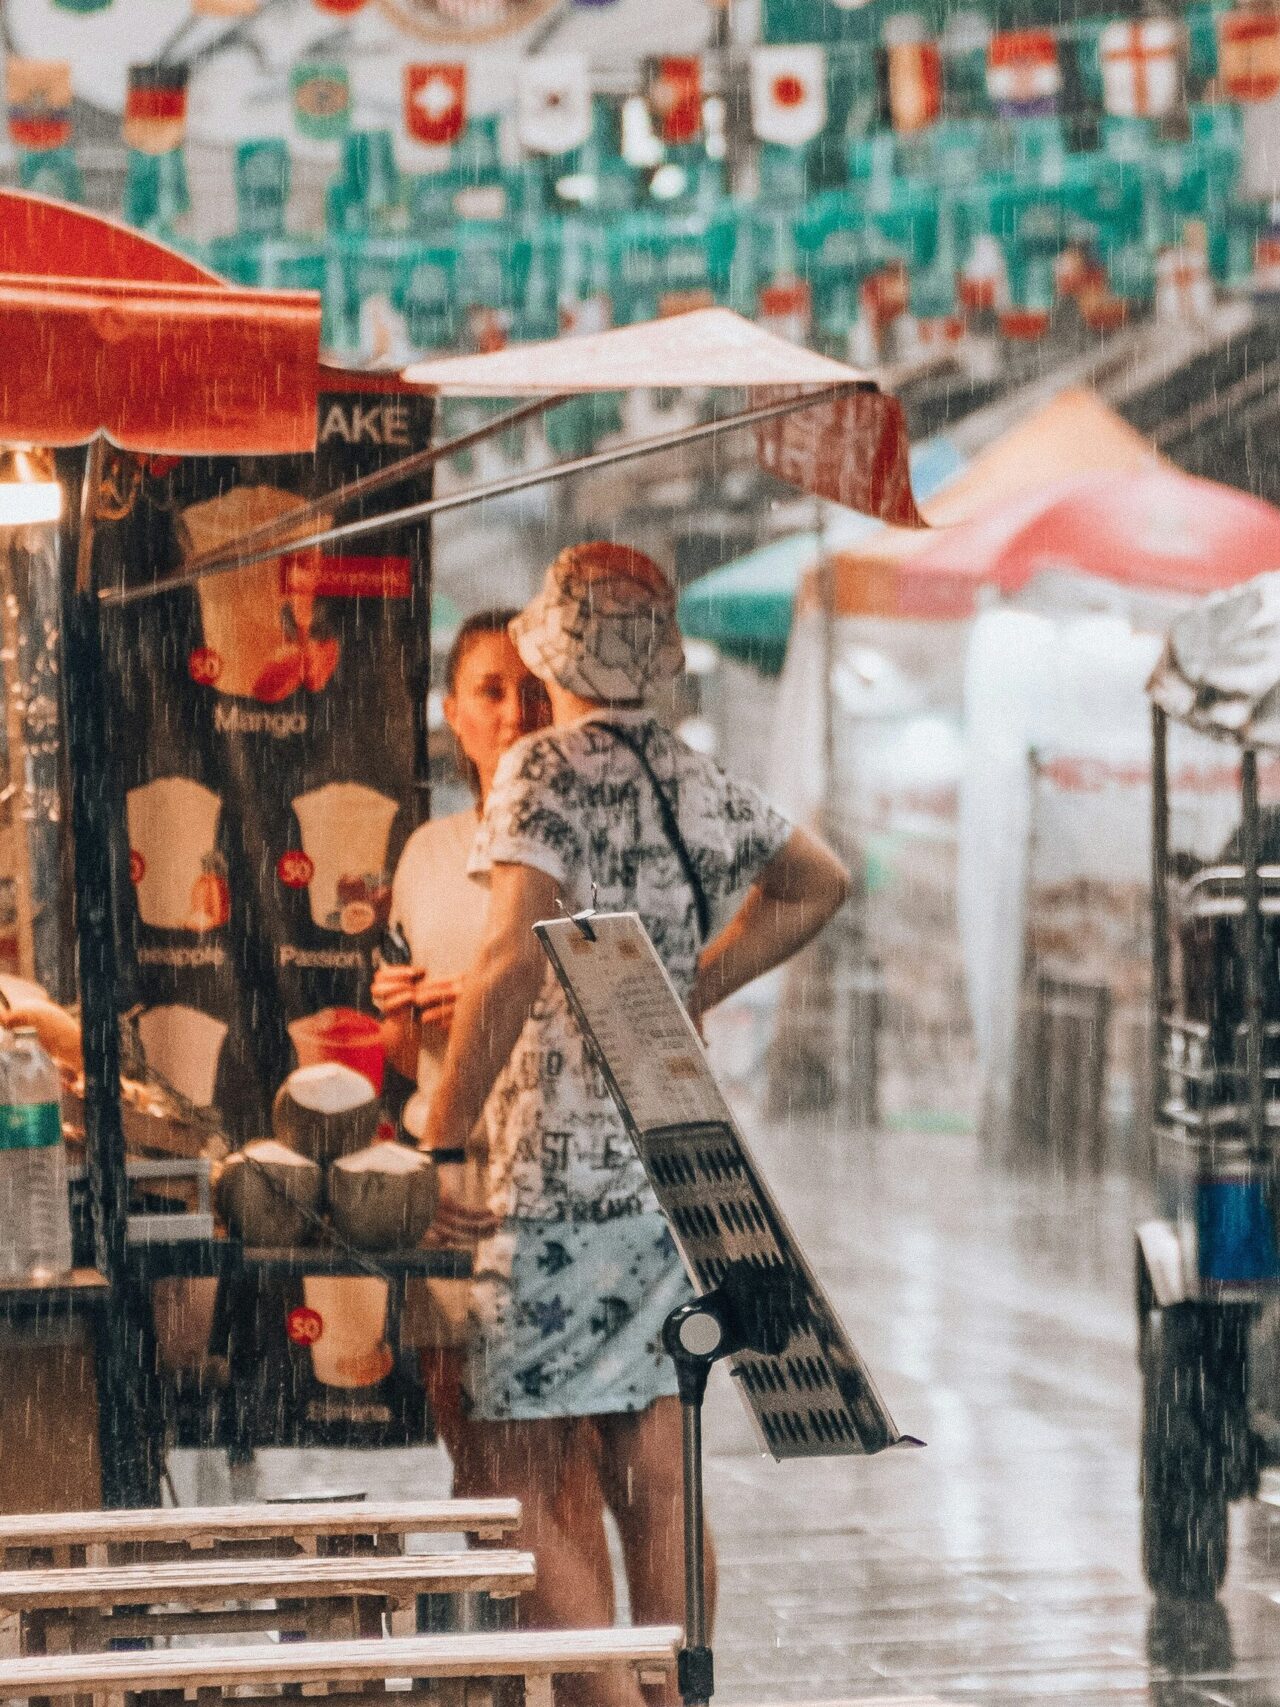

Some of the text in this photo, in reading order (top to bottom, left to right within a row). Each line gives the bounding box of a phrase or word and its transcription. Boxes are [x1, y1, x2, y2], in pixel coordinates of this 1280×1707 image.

[319, 404, 411, 445] AKE
[213, 702, 307, 738] Mango
[279, 944, 365, 968] Passion
[290, 1315, 321, 1339] 50
